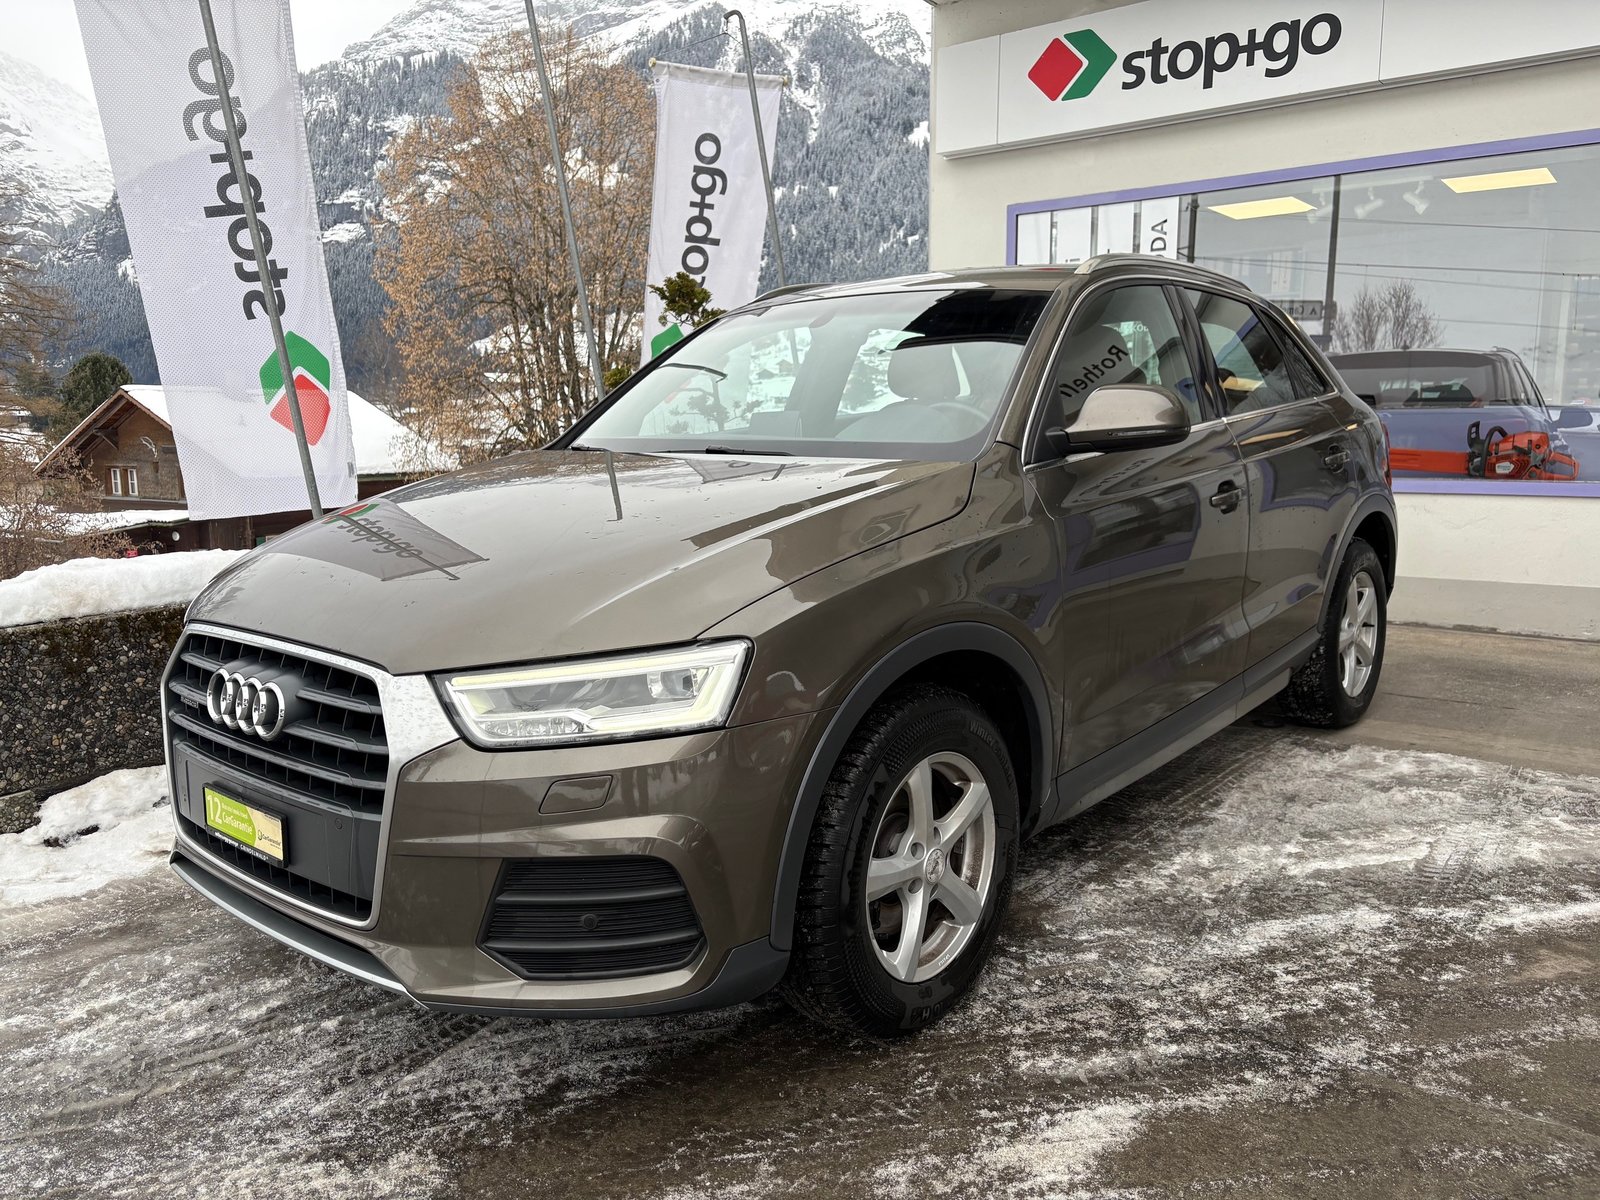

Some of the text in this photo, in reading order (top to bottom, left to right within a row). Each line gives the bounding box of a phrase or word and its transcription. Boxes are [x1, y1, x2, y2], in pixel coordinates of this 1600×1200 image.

[1121, 12, 1342, 90] stop+go
[681, 132, 728, 288] op+go
[206, 794, 223, 825] 12
